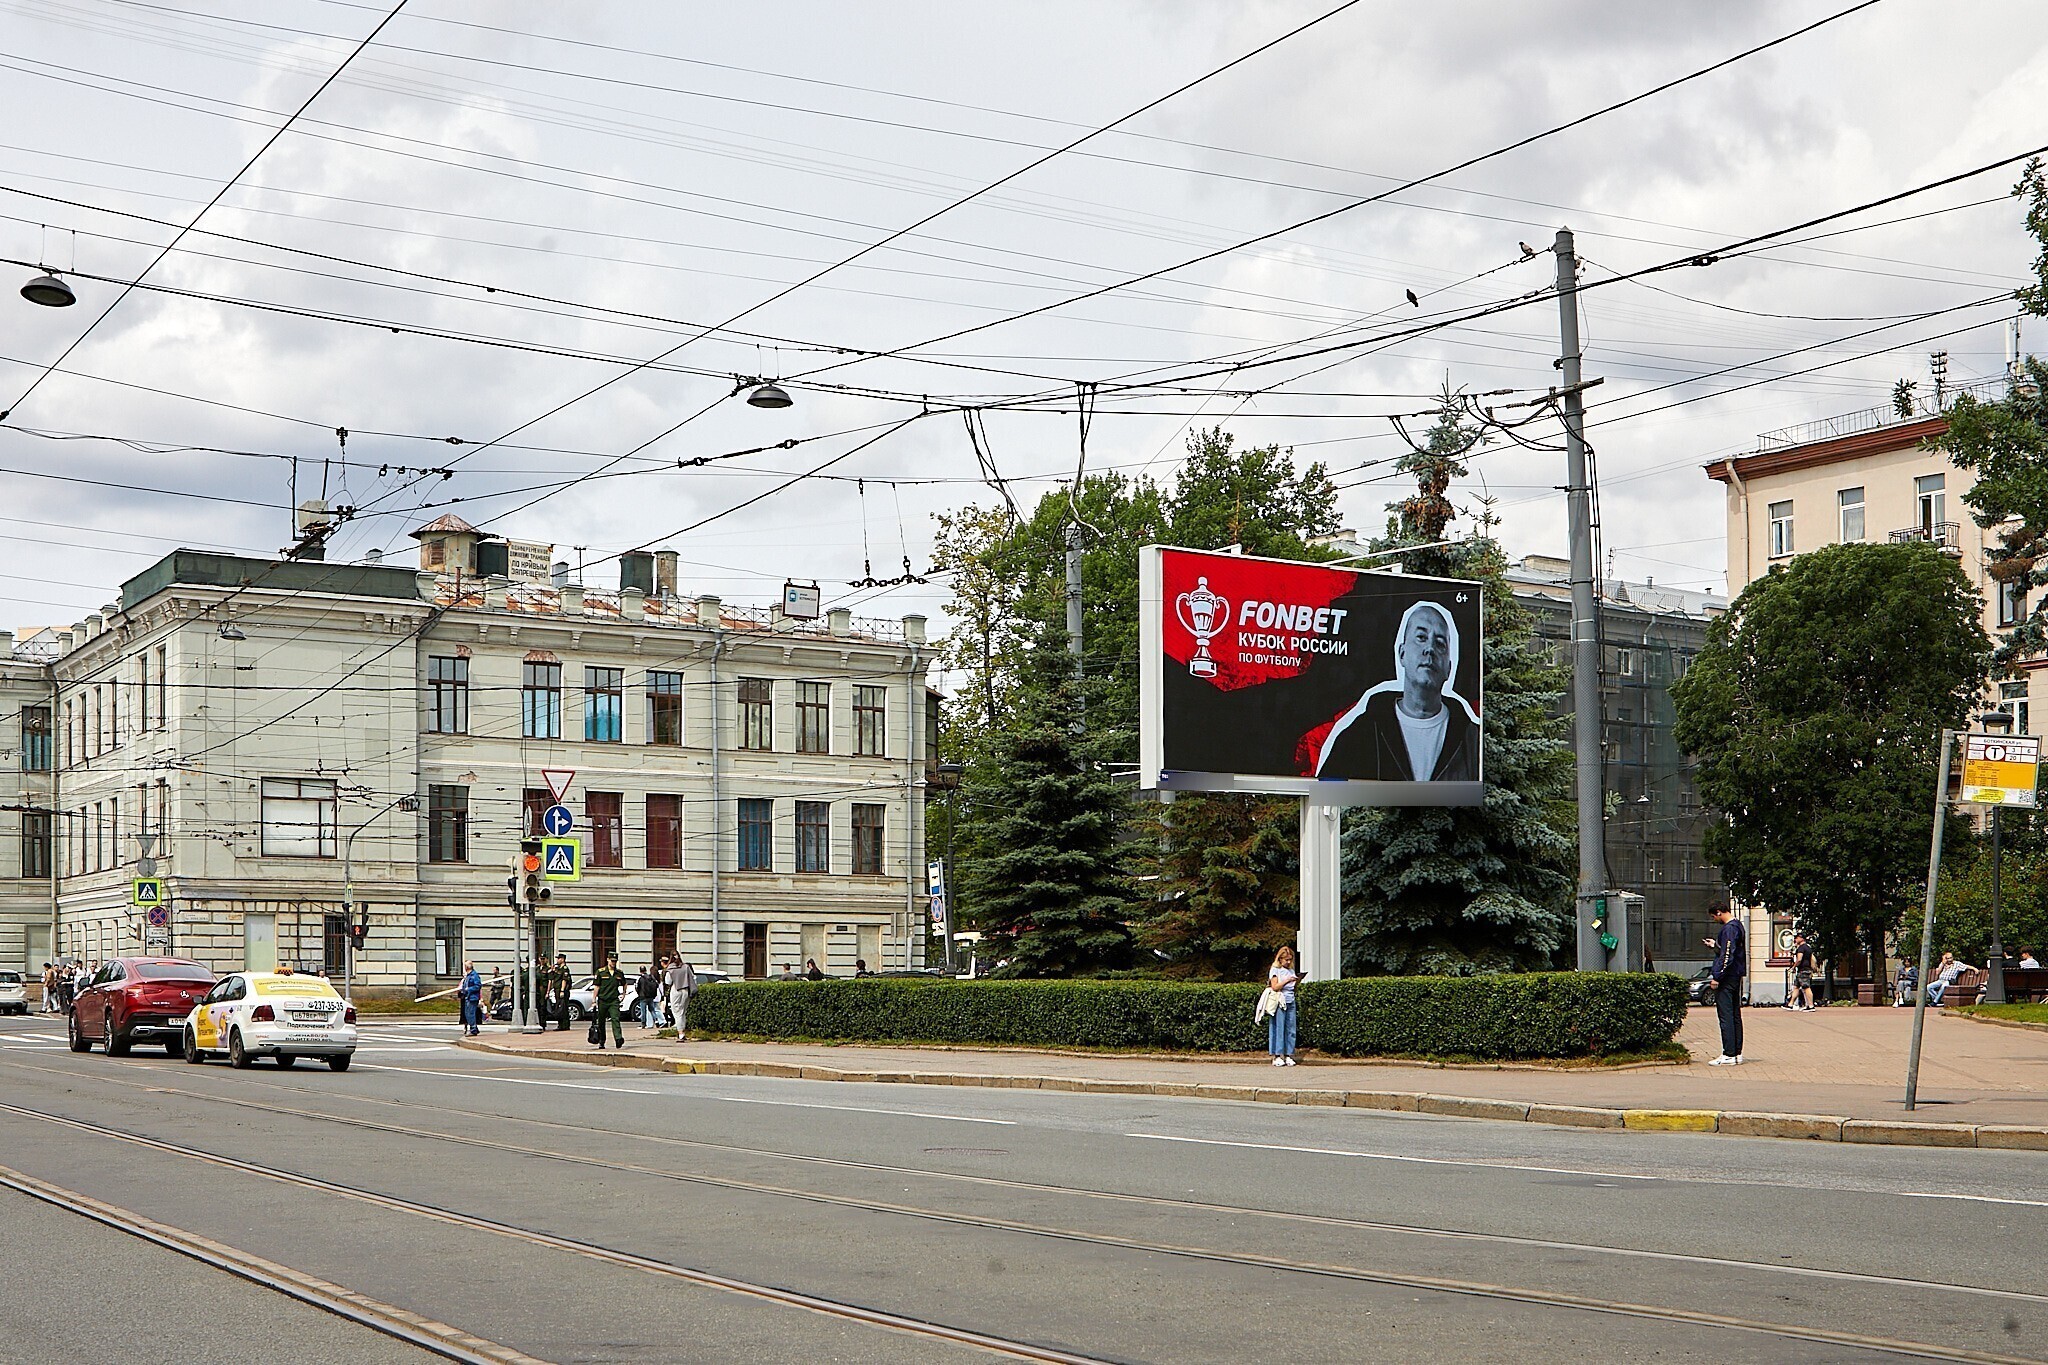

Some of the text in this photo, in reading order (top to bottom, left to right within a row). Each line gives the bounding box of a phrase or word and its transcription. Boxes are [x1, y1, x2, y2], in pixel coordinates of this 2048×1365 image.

[521, 561, 547, 570] КРИВЫМ
[1456, 591, 1468, 603] 6+
[1238, 600, 1347, 634] FONBET
[1238, 632, 1348, 656] КУБОК РОССИИ
[1239, 652, 1301, 667] ПО ФУТБОЛУ
[313, 1001, 343, 1011] 237-35-35
